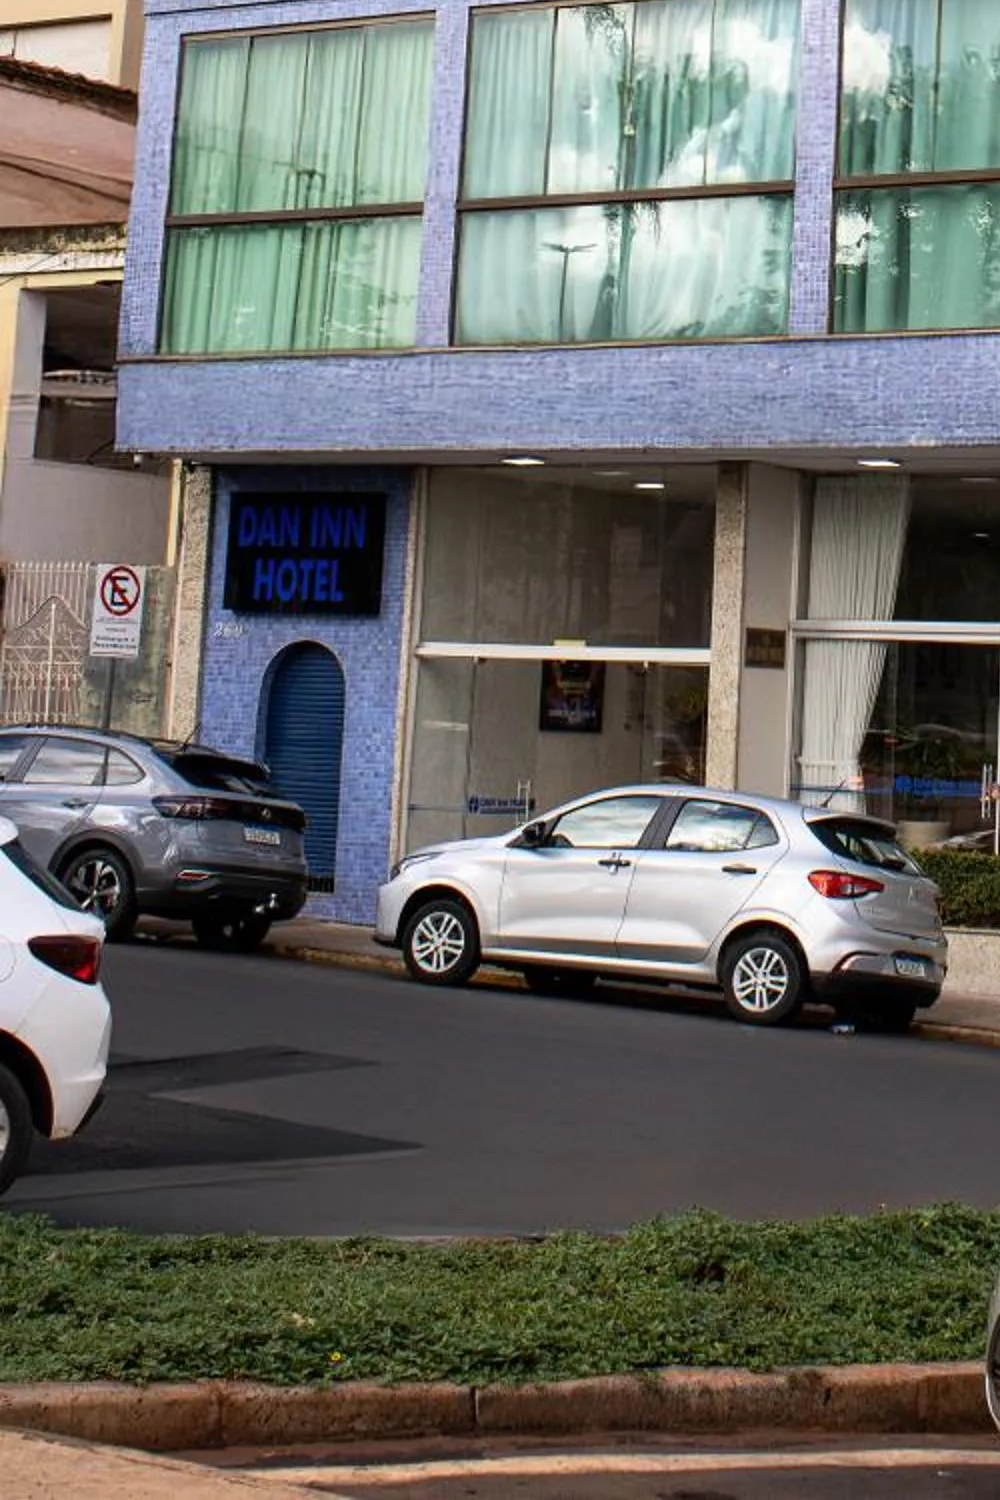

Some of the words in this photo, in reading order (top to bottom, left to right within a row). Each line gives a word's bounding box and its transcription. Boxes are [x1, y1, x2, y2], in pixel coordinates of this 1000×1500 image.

[238, 504, 300, 548] DAN
[311, 503, 367, 549] INN
[253, 557, 345, 603] HOTEL
